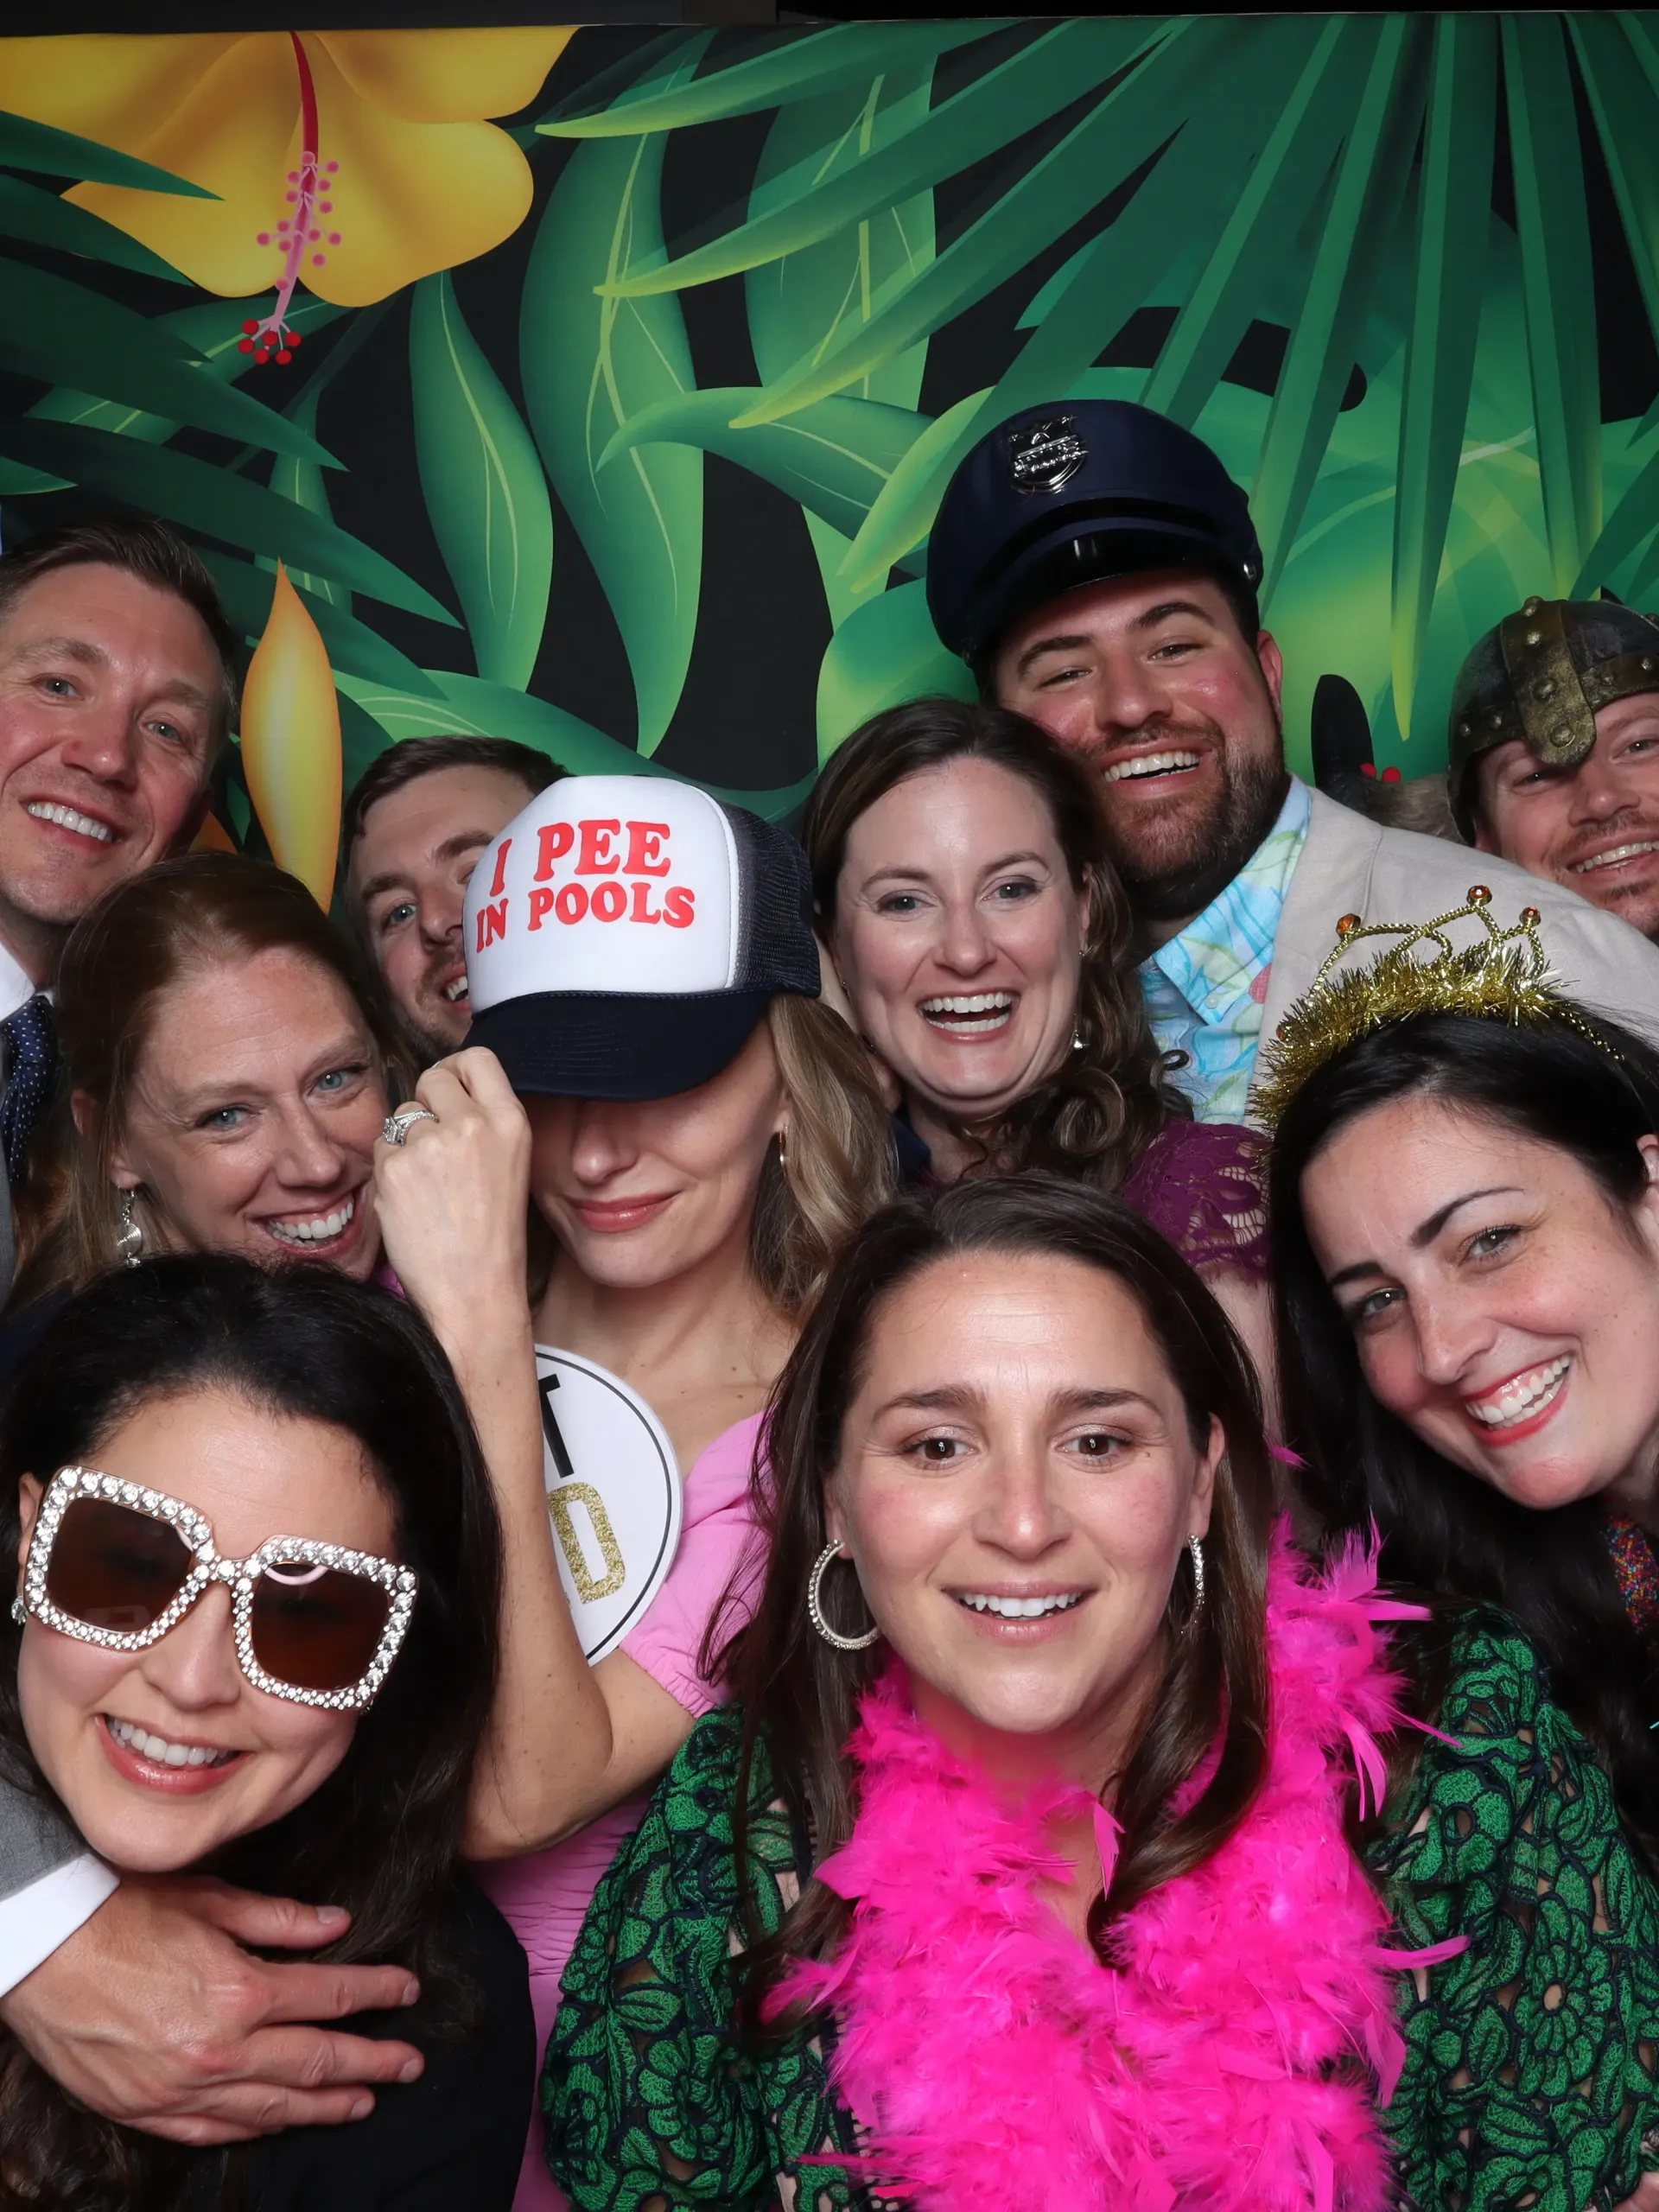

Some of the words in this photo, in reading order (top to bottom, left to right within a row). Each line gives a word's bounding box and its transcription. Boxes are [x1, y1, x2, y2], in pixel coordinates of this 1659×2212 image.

[489, 838, 512, 897] I
[533, 818, 671, 882] PEE
[476, 898, 509, 953] IN
[527, 880, 696, 931] POOLS
